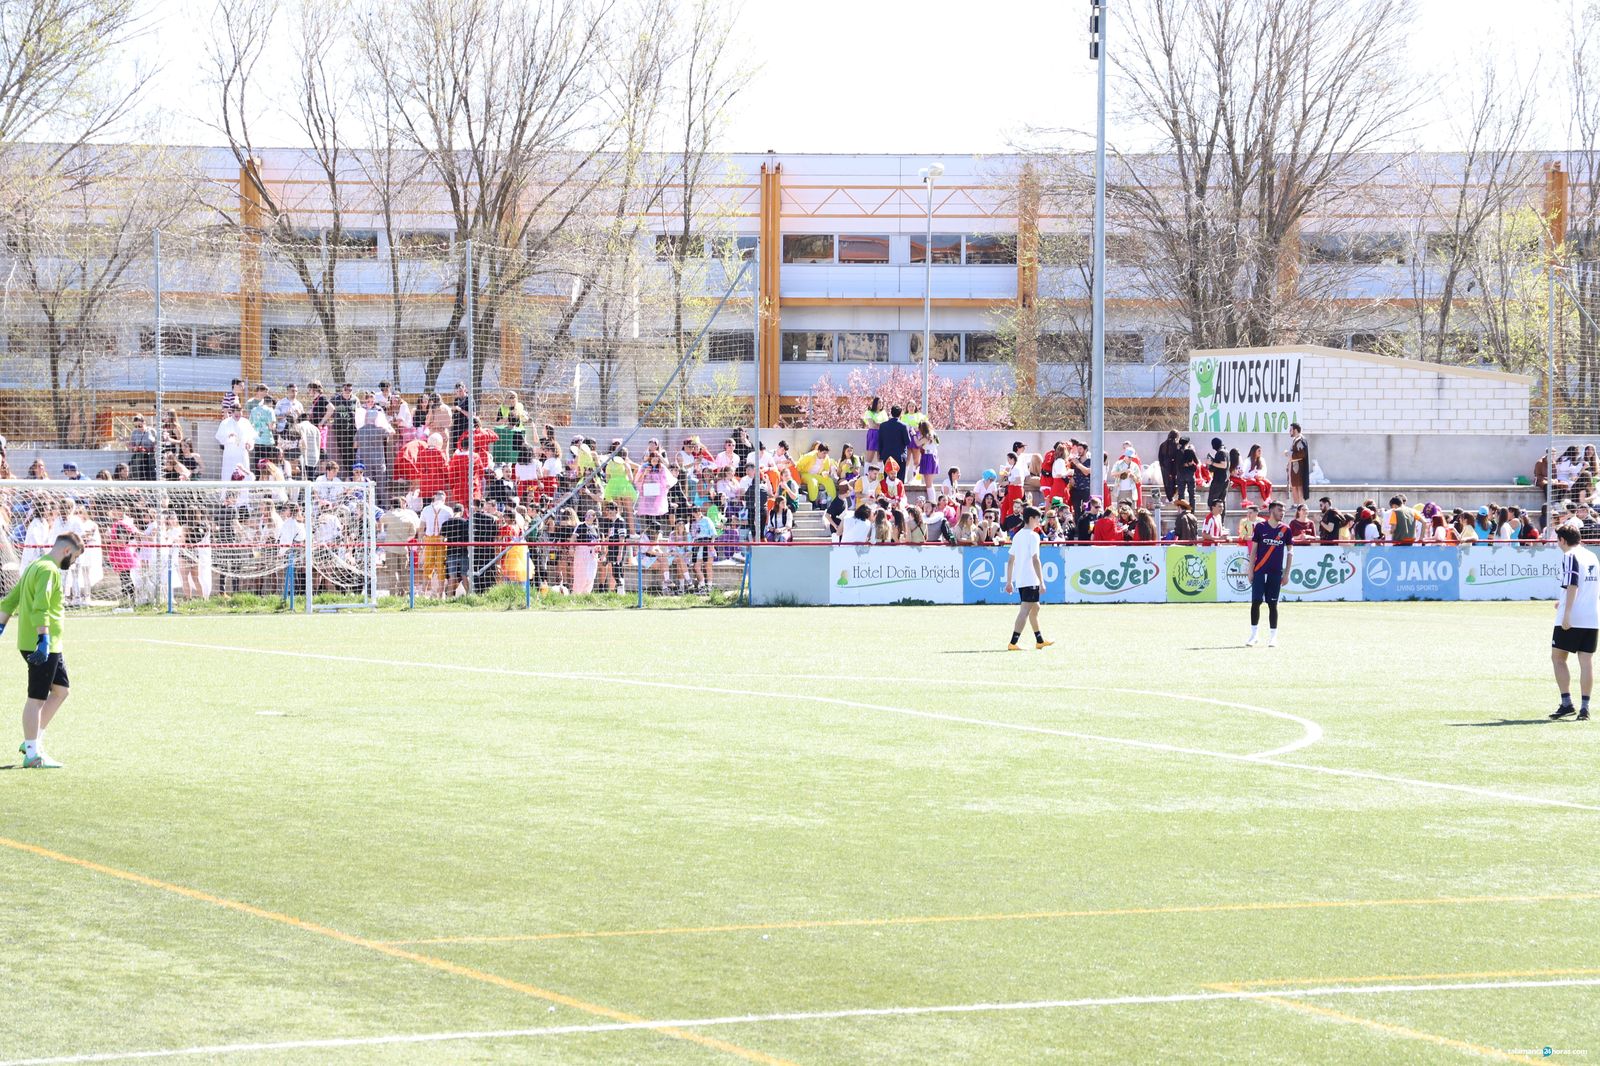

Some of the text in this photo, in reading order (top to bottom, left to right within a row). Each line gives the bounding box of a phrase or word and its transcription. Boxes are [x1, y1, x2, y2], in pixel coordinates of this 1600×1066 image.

[1214, 359, 1301, 404] AUTOESCUELA
[853, 565, 882, 579] Hotel
[887, 565, 917, 579] Doña
[1079, 553, 1154, 590] socfer
[1289, 553, 1350, 589] ocfer
[1396, 560, 1453, 581] JAKO
[1480, 563, 1507, 577] Hotel
[1511, 563, 1538, 577] Doña
[1396, 584, 1439, 592] LIVING SPORTS
